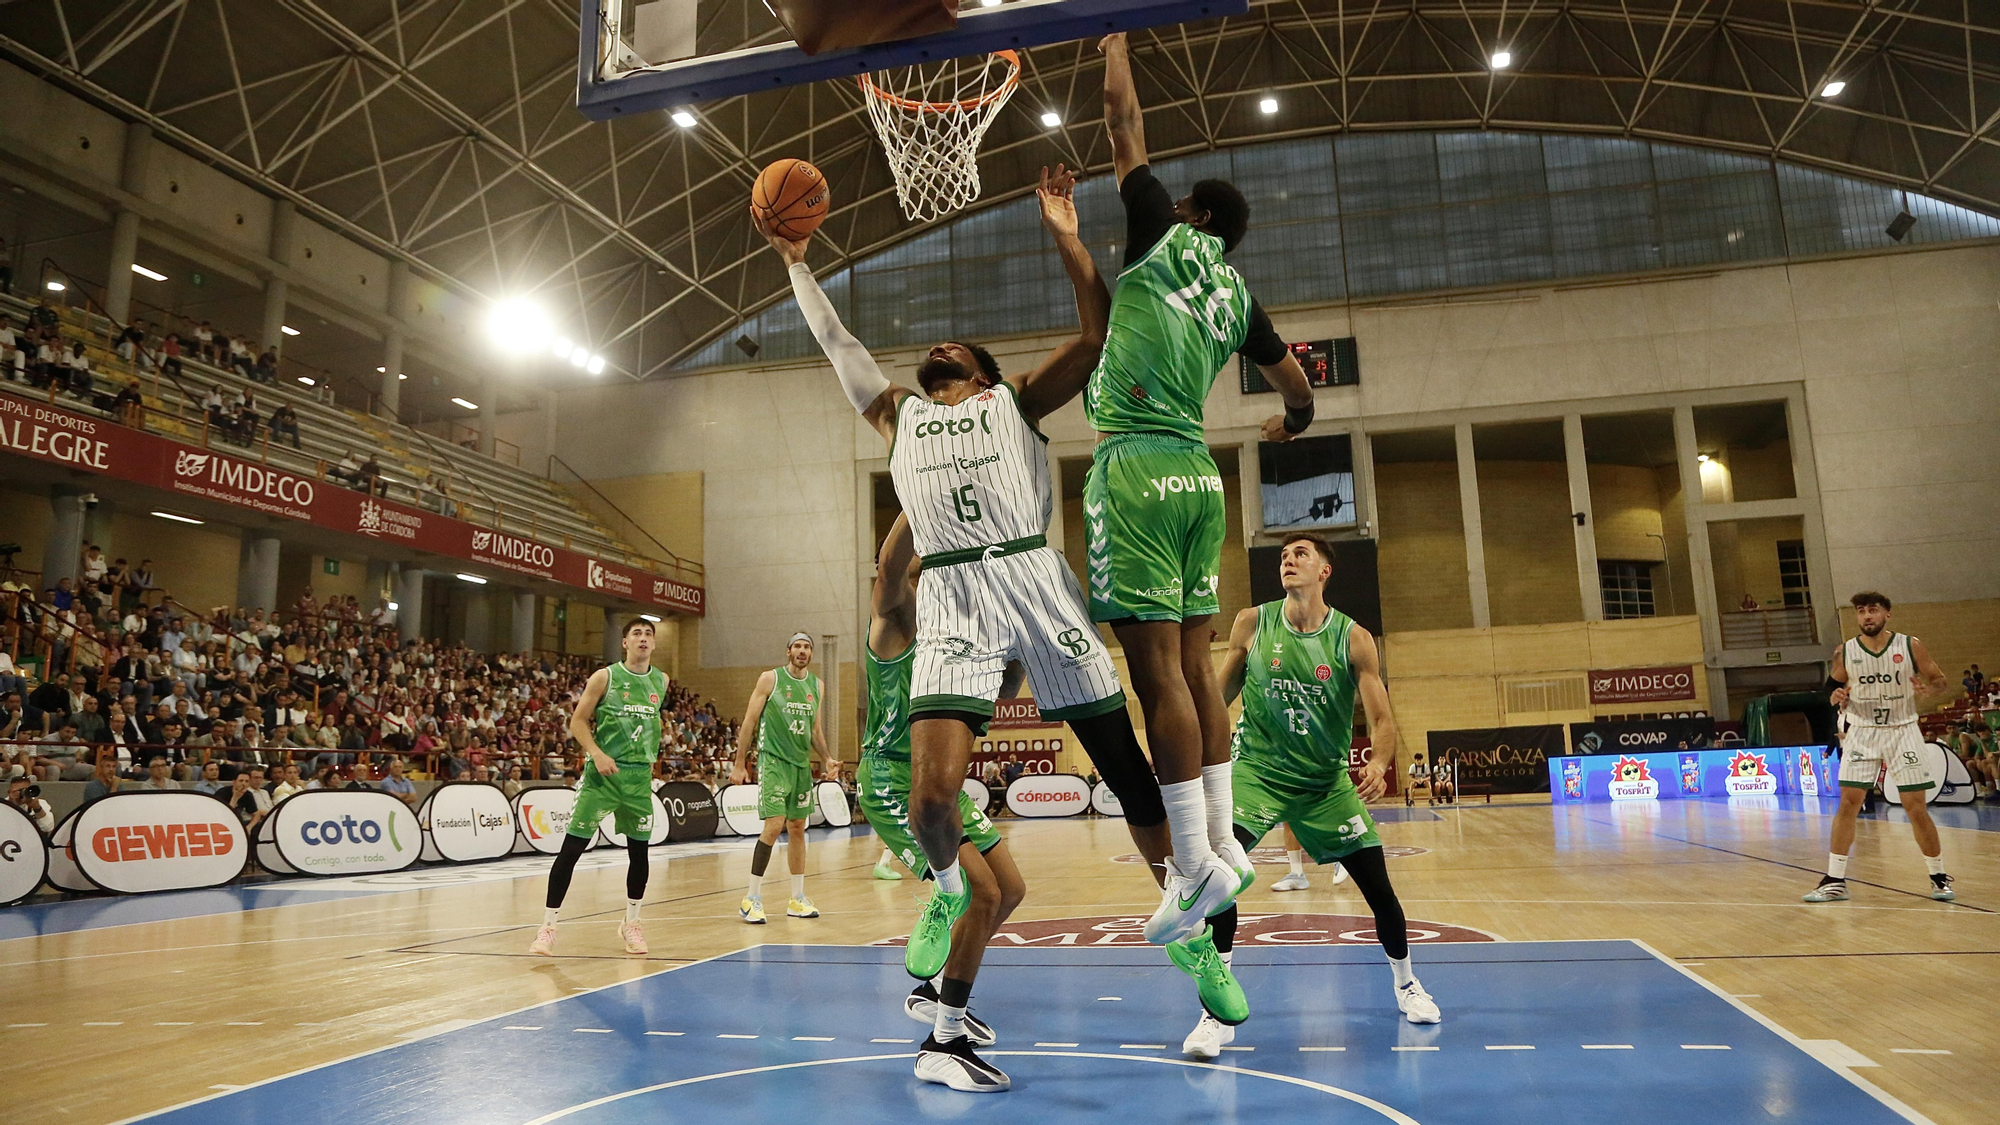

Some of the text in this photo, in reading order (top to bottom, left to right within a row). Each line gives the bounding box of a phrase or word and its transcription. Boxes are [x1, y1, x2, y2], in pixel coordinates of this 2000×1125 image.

[35, 408, 97, 434] DEPORTES
[915, 418, 975, 439] coto
[915, 452, 1001, 475] Fundación Cajasol
[210, 456, 314, 506] IMDECO
[1151, 475, 1196, 501] you
[206, 488, 242, 503] Municipal
[243, 498, 252, 506] de
[950, 484, 982, 523] 15
[492, 533, 554, 568] IMDECO
[665, 582, 701, 605] IMDECO
[1271, 678, 1323, 695] AMICS
[1615, 673, 1690, 692] IMDECO
[1858, 672, 1892, 685] coto
[623, 704, 655, 714] AMICS
[786, 701, 811, 710] AMICS
[995, 704, 1041, 719] IMDE
[1283, 707, 1311, 735] 13
[1873, 708, 1891, 725] 27
[631, 724, 643, 742] 4
[789, 719, 806, 735] 42
[1619, 731, 1667, 745] COVAP
[1460, 767, 1535, 778] SELECCIÓN
[1616, 786, 1651, 795] TOSFRIT
[1733, 782, 1769, 791] TOSFRIT
[687, 799, 712, 811] nogomet
[1016, 790, 1081, 802] CÓRDOBA
[301, 814, 381, 846] coto
[437, 812, 509, 831] Fundación Cajasol
